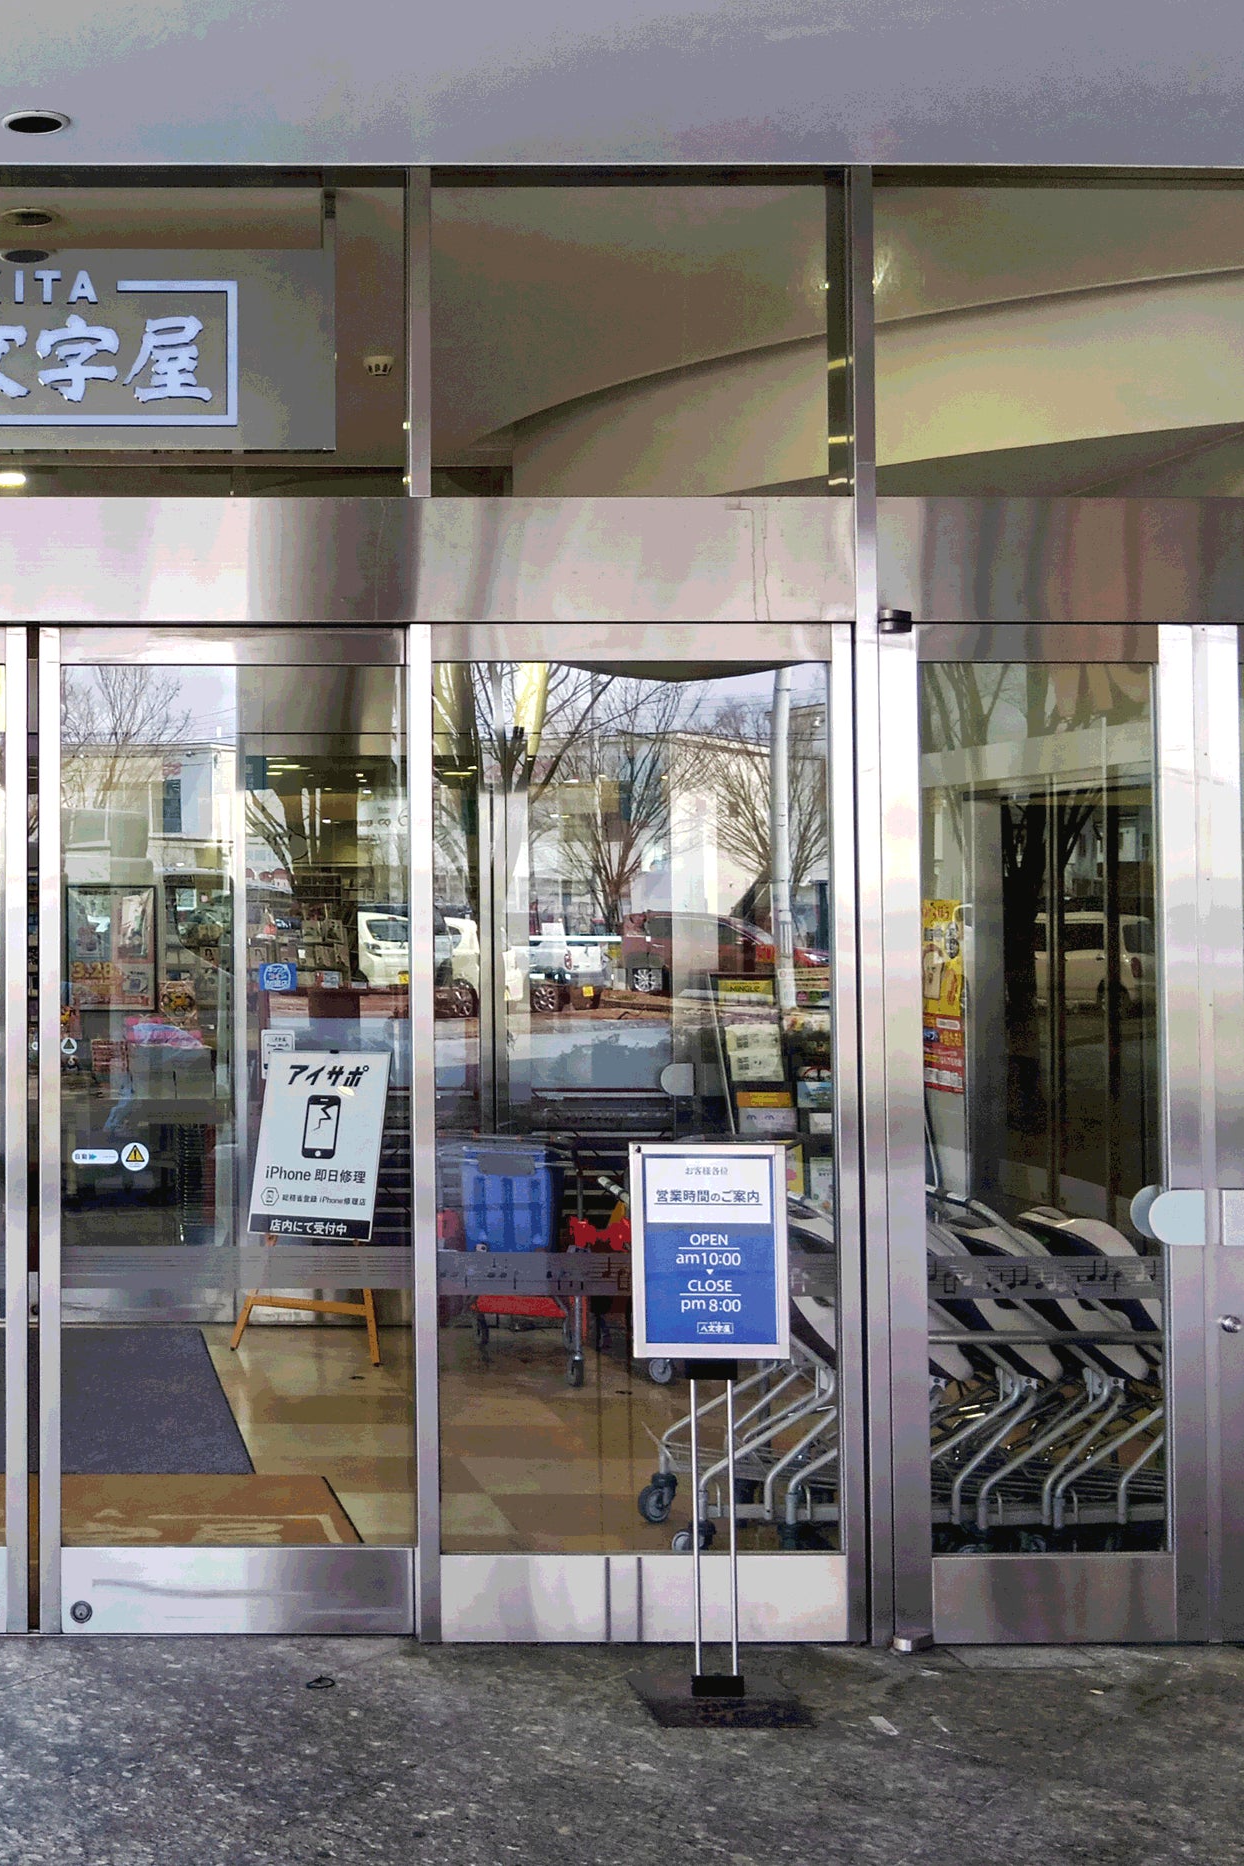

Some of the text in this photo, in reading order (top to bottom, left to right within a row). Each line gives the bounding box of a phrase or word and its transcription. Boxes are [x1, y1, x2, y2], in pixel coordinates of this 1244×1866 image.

[287, 1065, 370, 1088] アイサポ
[265, 1165, 367, 1184] iPhone 即日修理
[685, 1166, 729, 1176] お客様各位
[656, 1189, 760, 1203] 営業時間のご案内
[269, 1219, 348, 1235] 店内にて受付中
[689, 1234, 729, 1246] OPEN
[687, 1280, 732, 1292] CLOSE
[680, 1299, 742, 1314] pm 8:00
